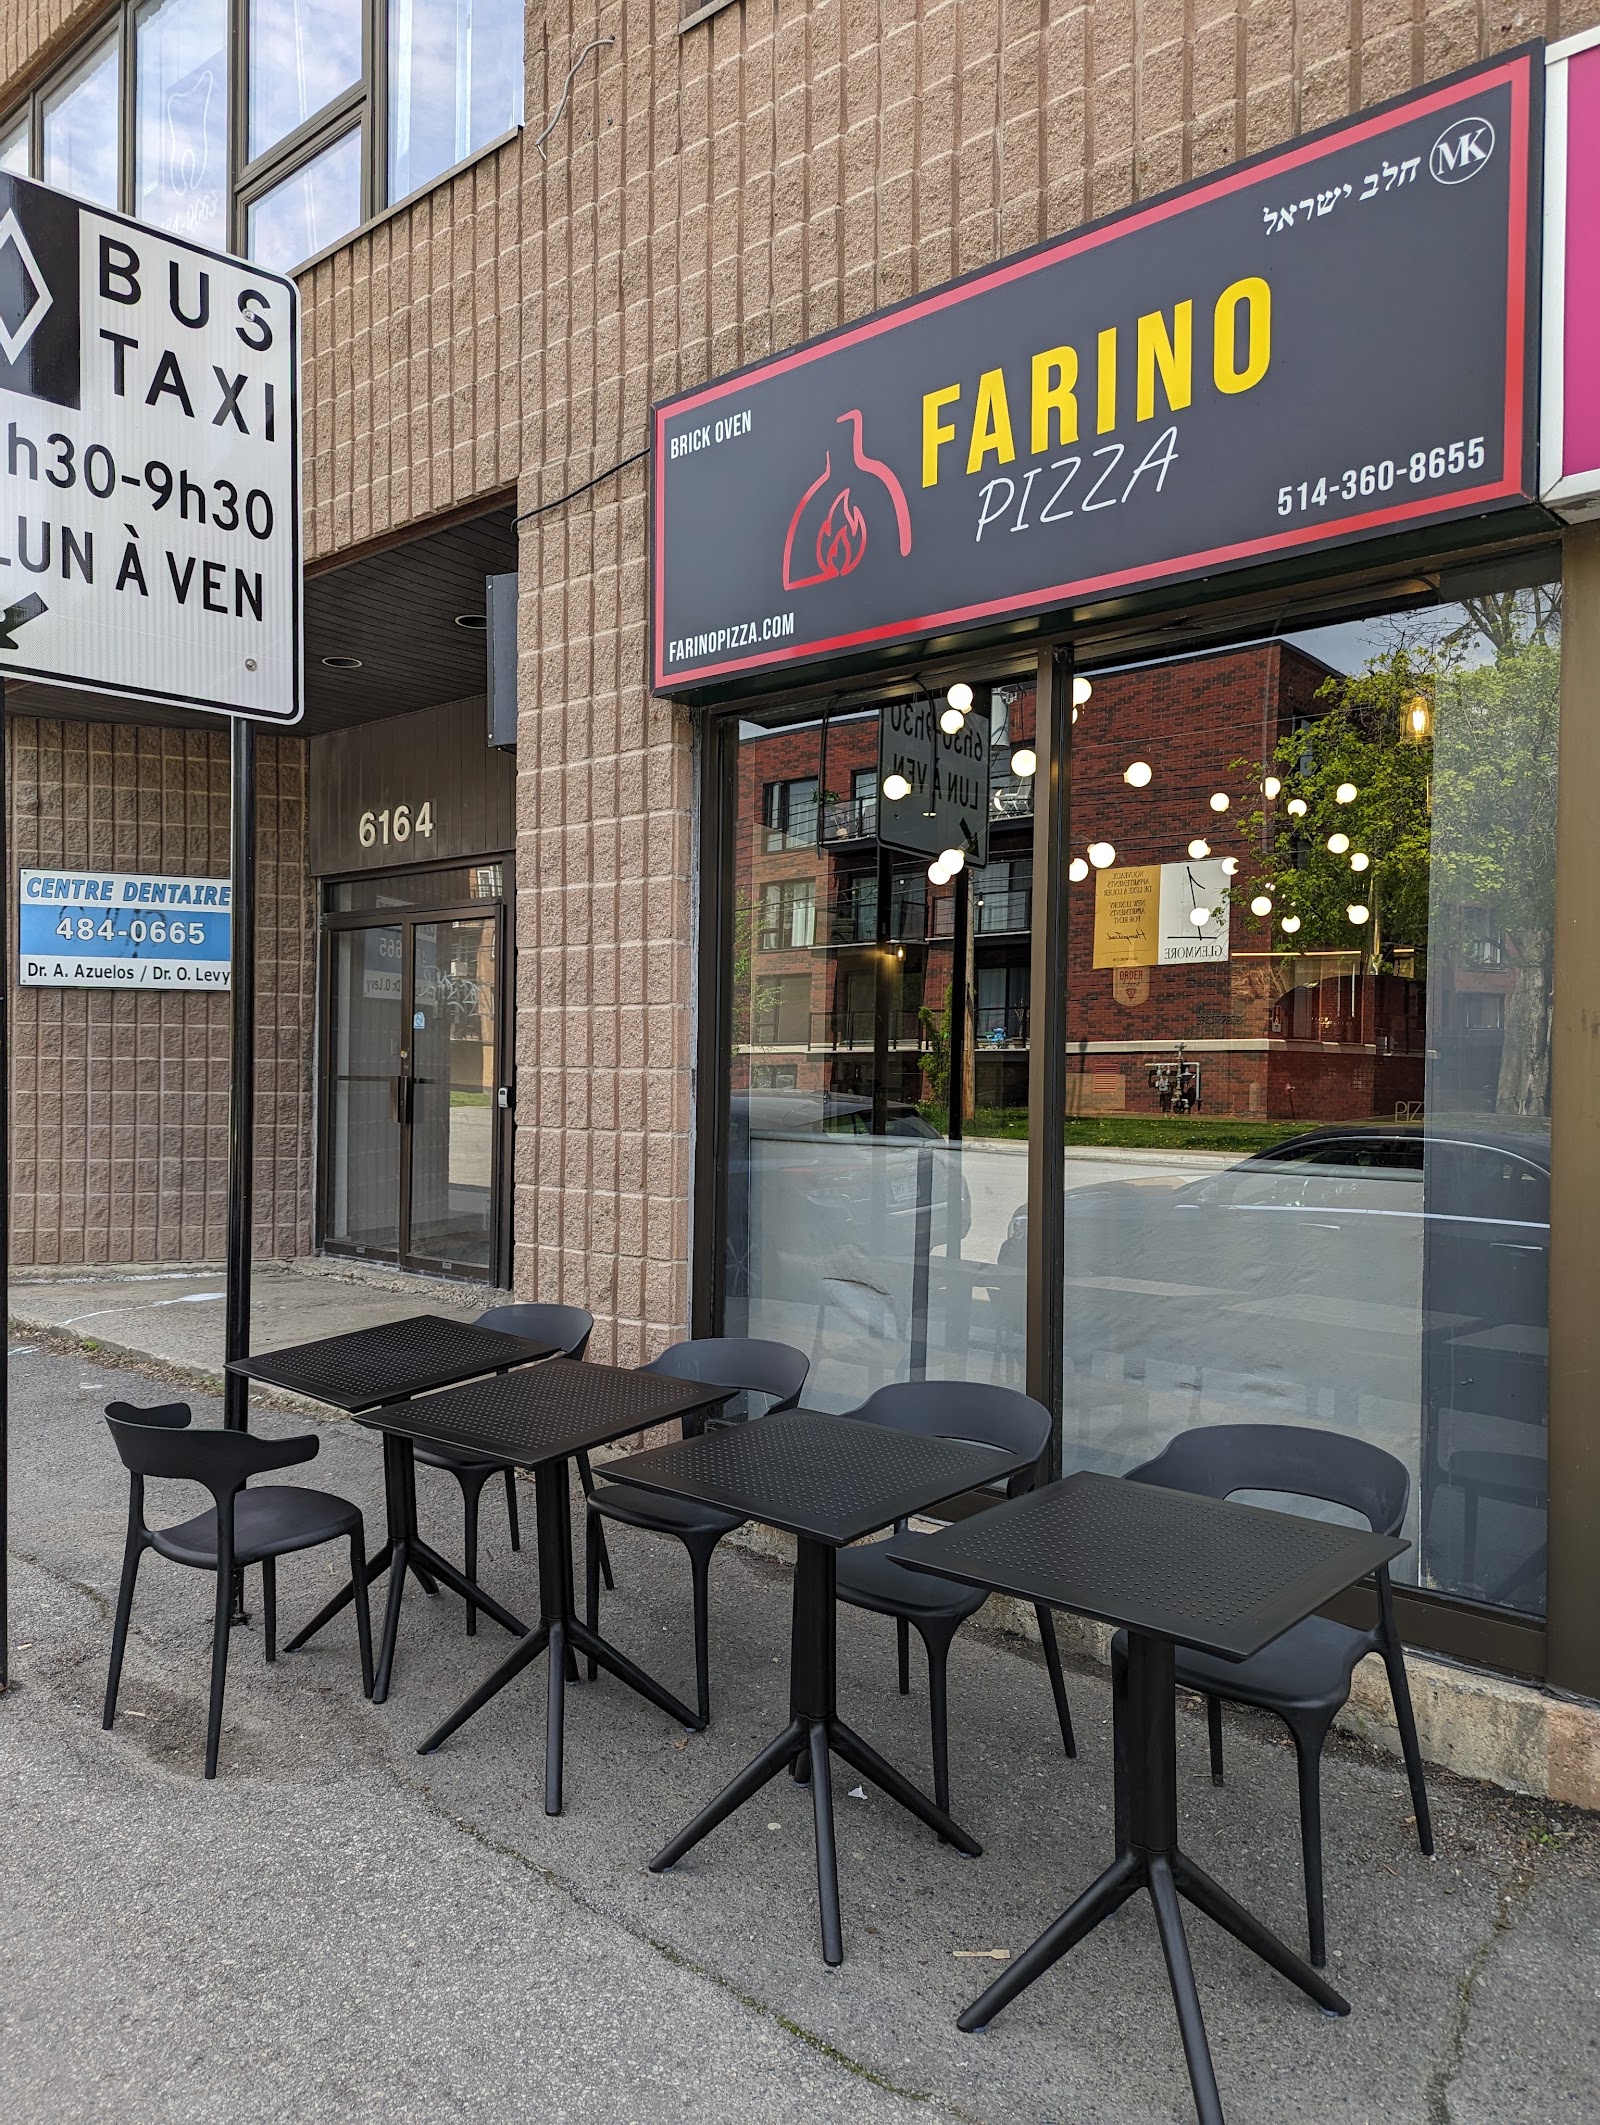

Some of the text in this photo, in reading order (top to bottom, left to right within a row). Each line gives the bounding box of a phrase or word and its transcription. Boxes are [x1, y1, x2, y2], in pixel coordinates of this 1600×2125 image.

[1436, 127, 1487, 176] MK
[1263, 156, 1421, 235] חלב ישראל
[99, 234, 274, 352] BUS
[99, 328, 275, 443] TAXI
[922, 276, 1272, 489] FARINO
[670, 409, 752, 460] BRICK OVEN
[8, 421, 274, 540] h30-9h30
[975, 426, 1179, 542] PIZZA
[1277, 436, 1486, 517] 514-360-8655
[115, 523, 149, 597] À
[166, 550, 262, 622] VEN
[669, 612, 794, 662] FARINOPIZZA.COM
[359, 802, 435, 848] 6164
[27, 877, 231, 906] CENTRE DENTAIRE
[56, 917, 205, 945] 484-0665
[28, 962, 47, 977] Dr.
[54, 963, 68, 978] A.
[74, 964, 134, 979] Azuelos
[153, 966, 171, 981] Dr.
[176, 967, 191, 981] O.
[196, 967, 231, 985] Levy
[1119, 970, 1143, 981] ORDER
[1395, 1100, 1424, 1123] PIZ
